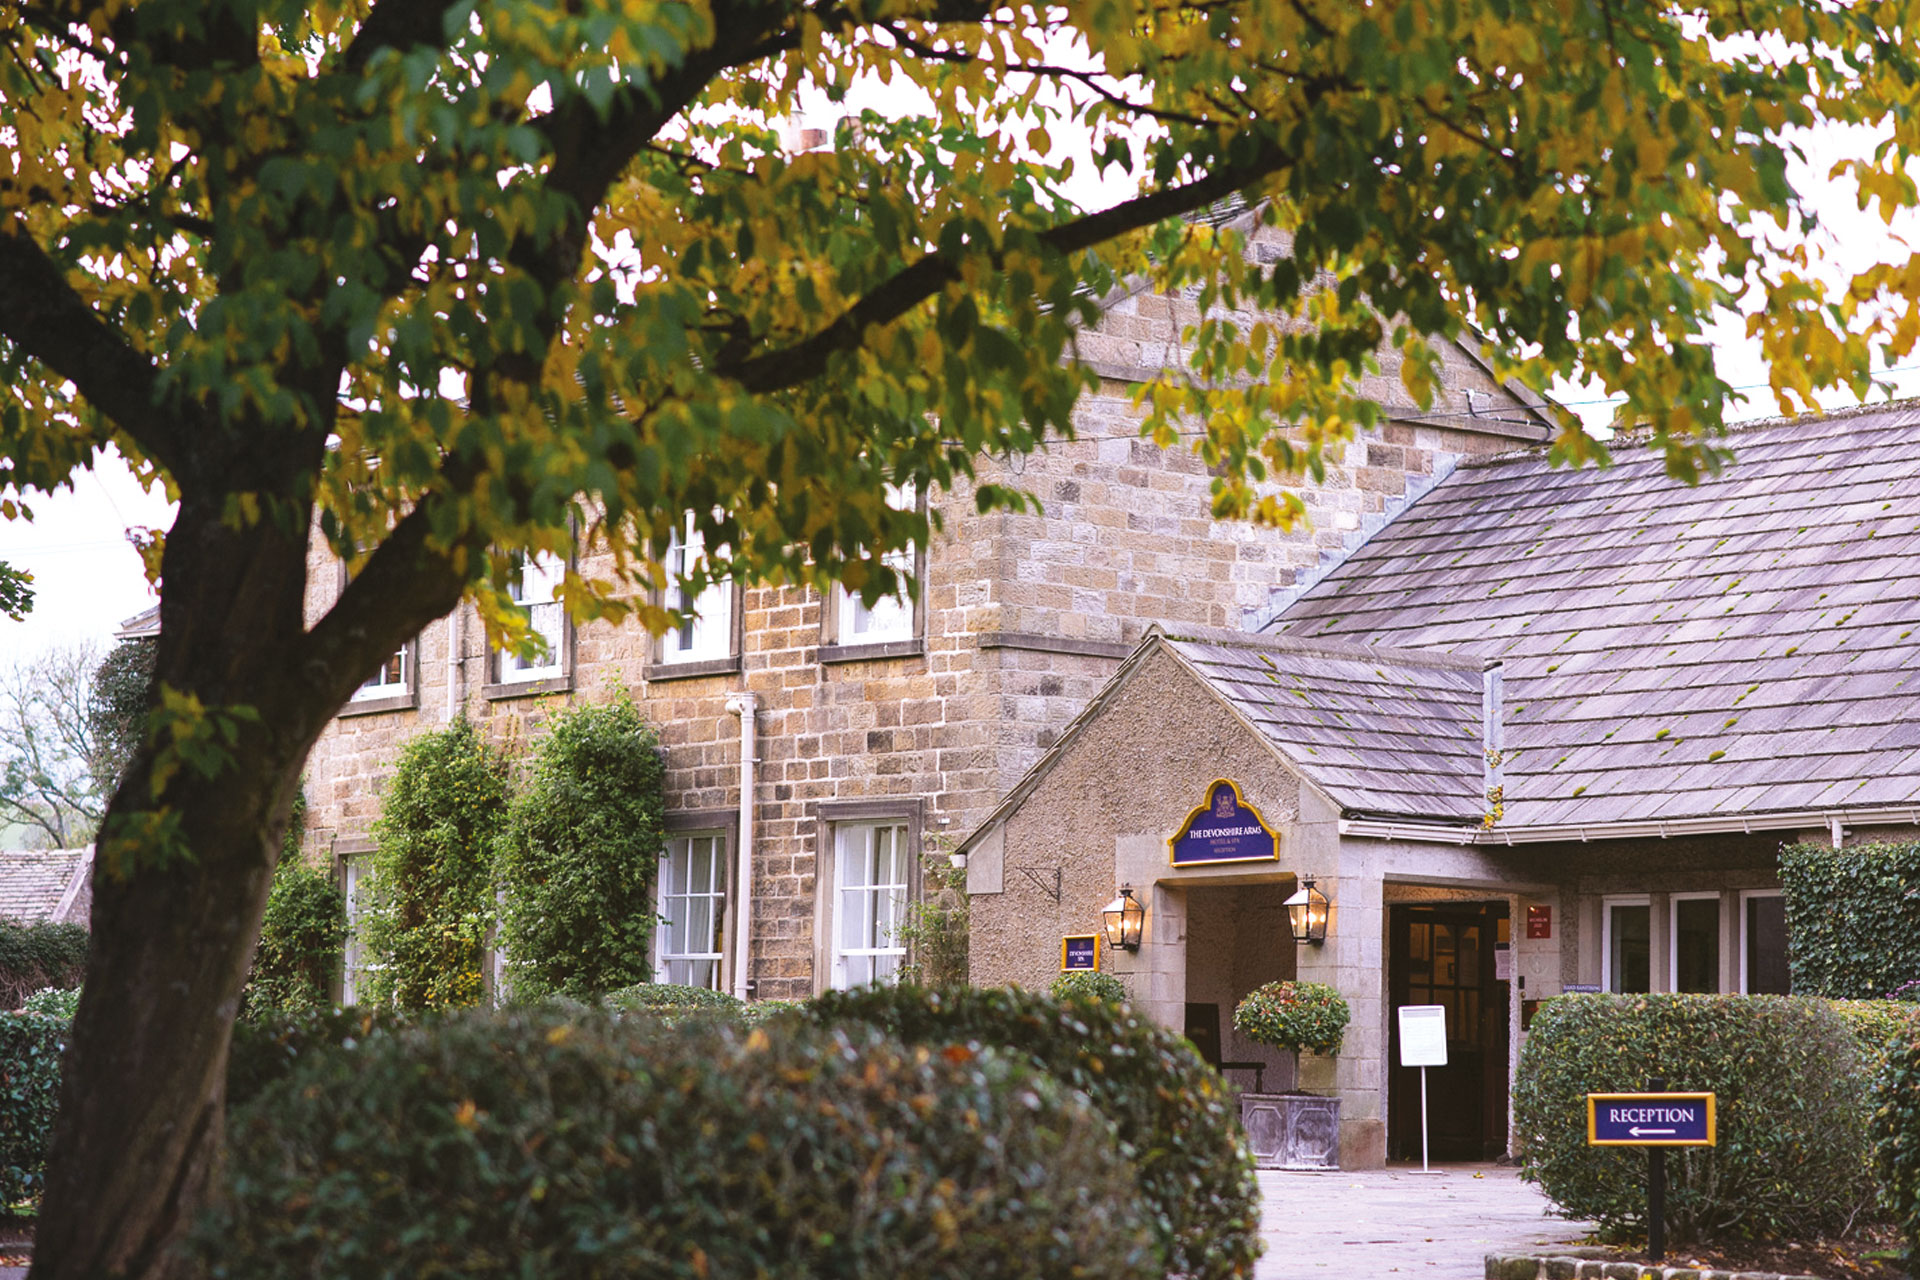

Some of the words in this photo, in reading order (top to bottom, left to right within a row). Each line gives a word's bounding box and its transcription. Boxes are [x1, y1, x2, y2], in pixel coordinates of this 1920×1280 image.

[1189, 829, 1202, 839] THE
[1202, 826, 1242, 838] DEVONSHIRE
[1243, 825, 1262, 835] ARMS
[1609, 1108, 1694, 1123] RECEPTION
